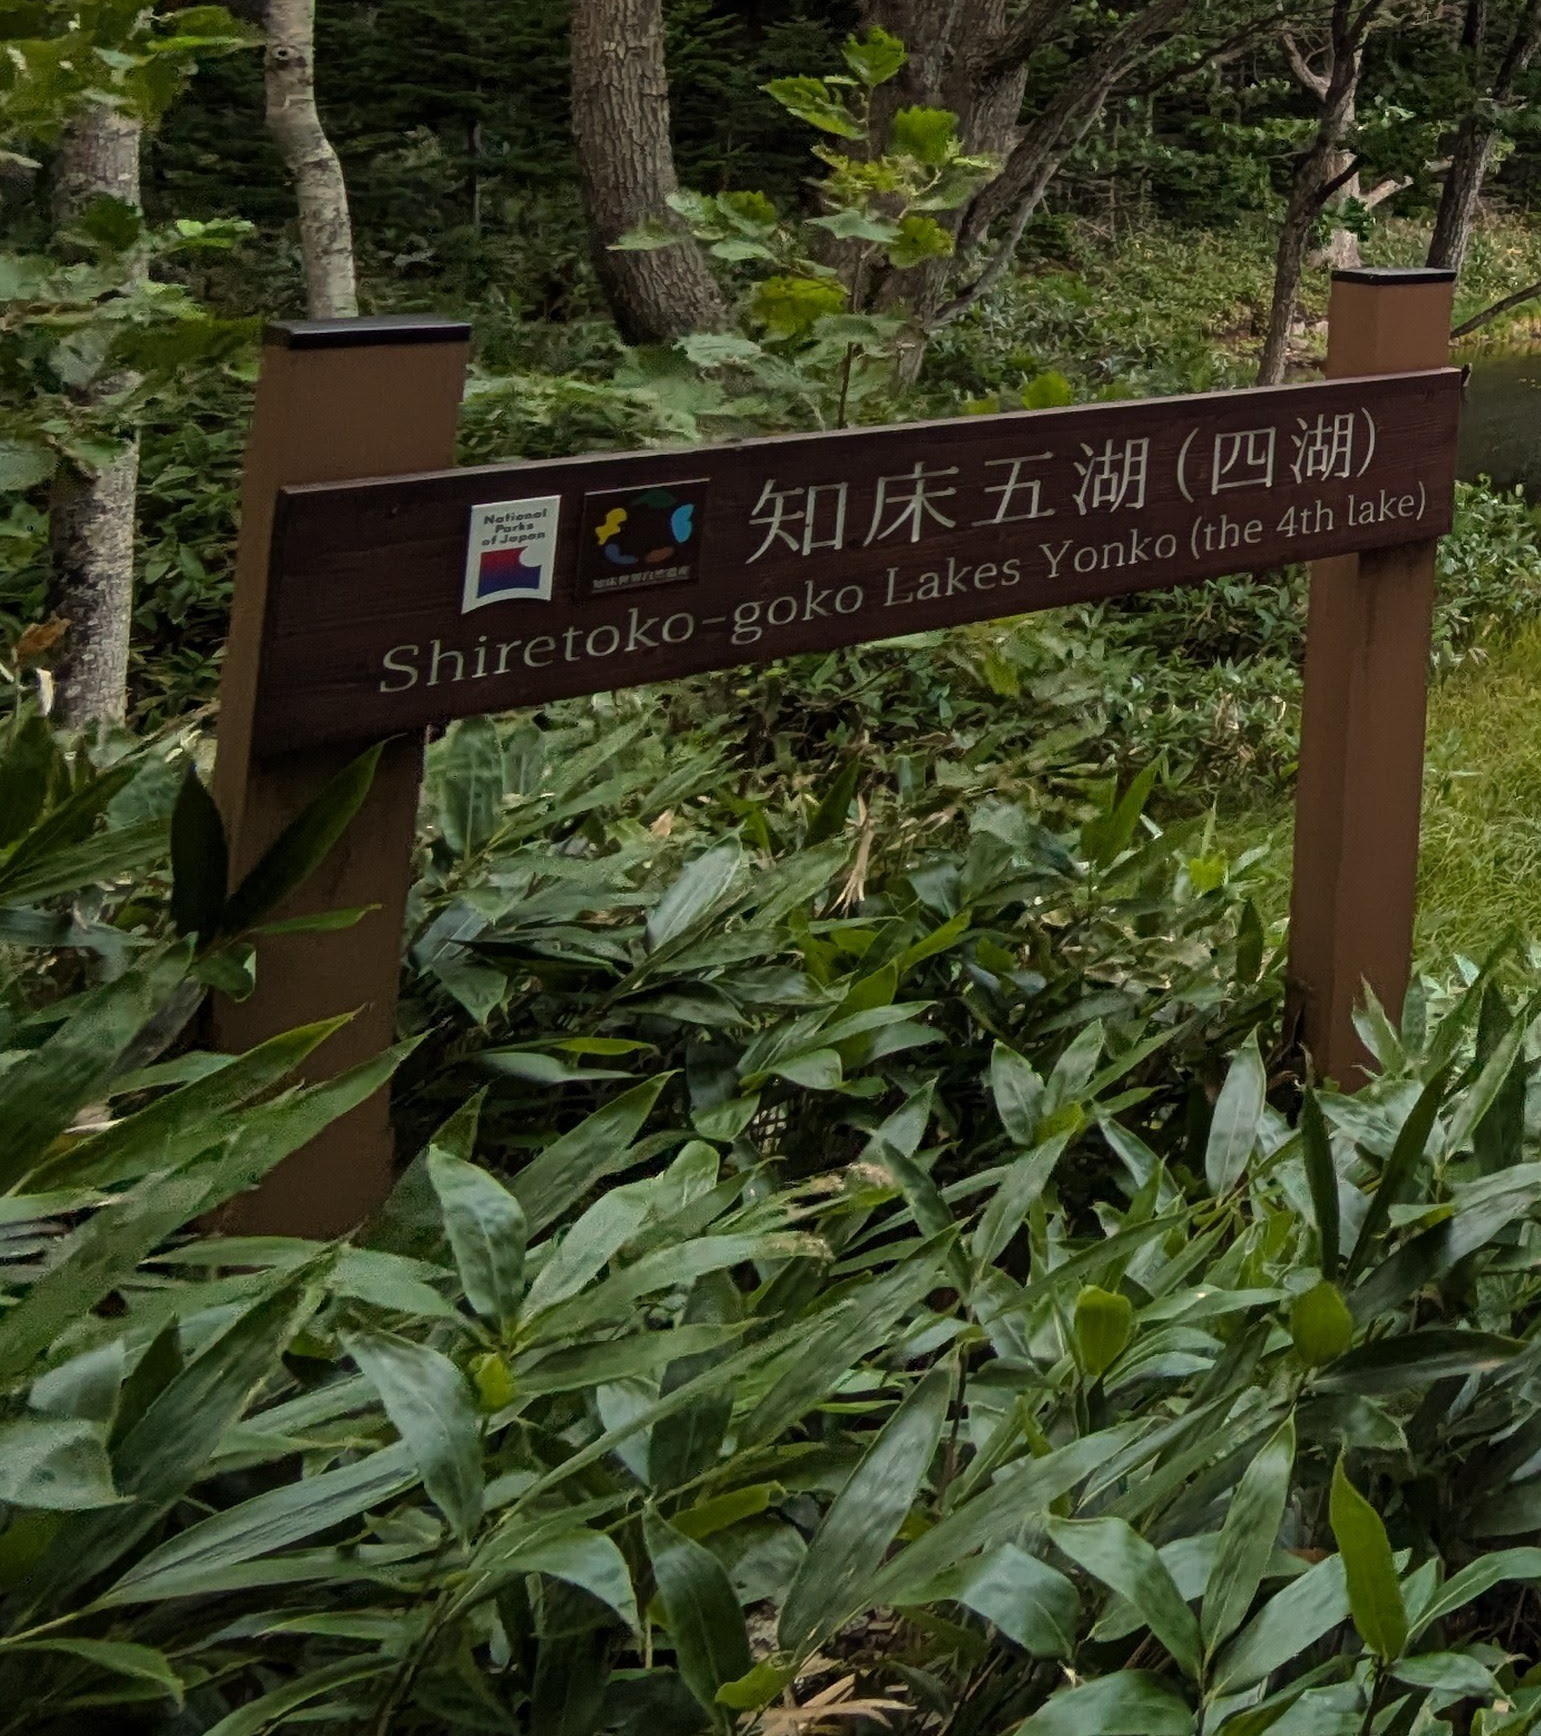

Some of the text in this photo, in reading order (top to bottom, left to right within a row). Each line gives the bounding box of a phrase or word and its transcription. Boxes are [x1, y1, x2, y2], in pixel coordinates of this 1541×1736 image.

[484, 507, 548, 525] National
[495, 522, 534, 534] Parks
[481, 532, 546, 546] of Japan
[380, 481, 1428, 693] Shiretoko-goko Lakes Yonko (the 4th lake)
